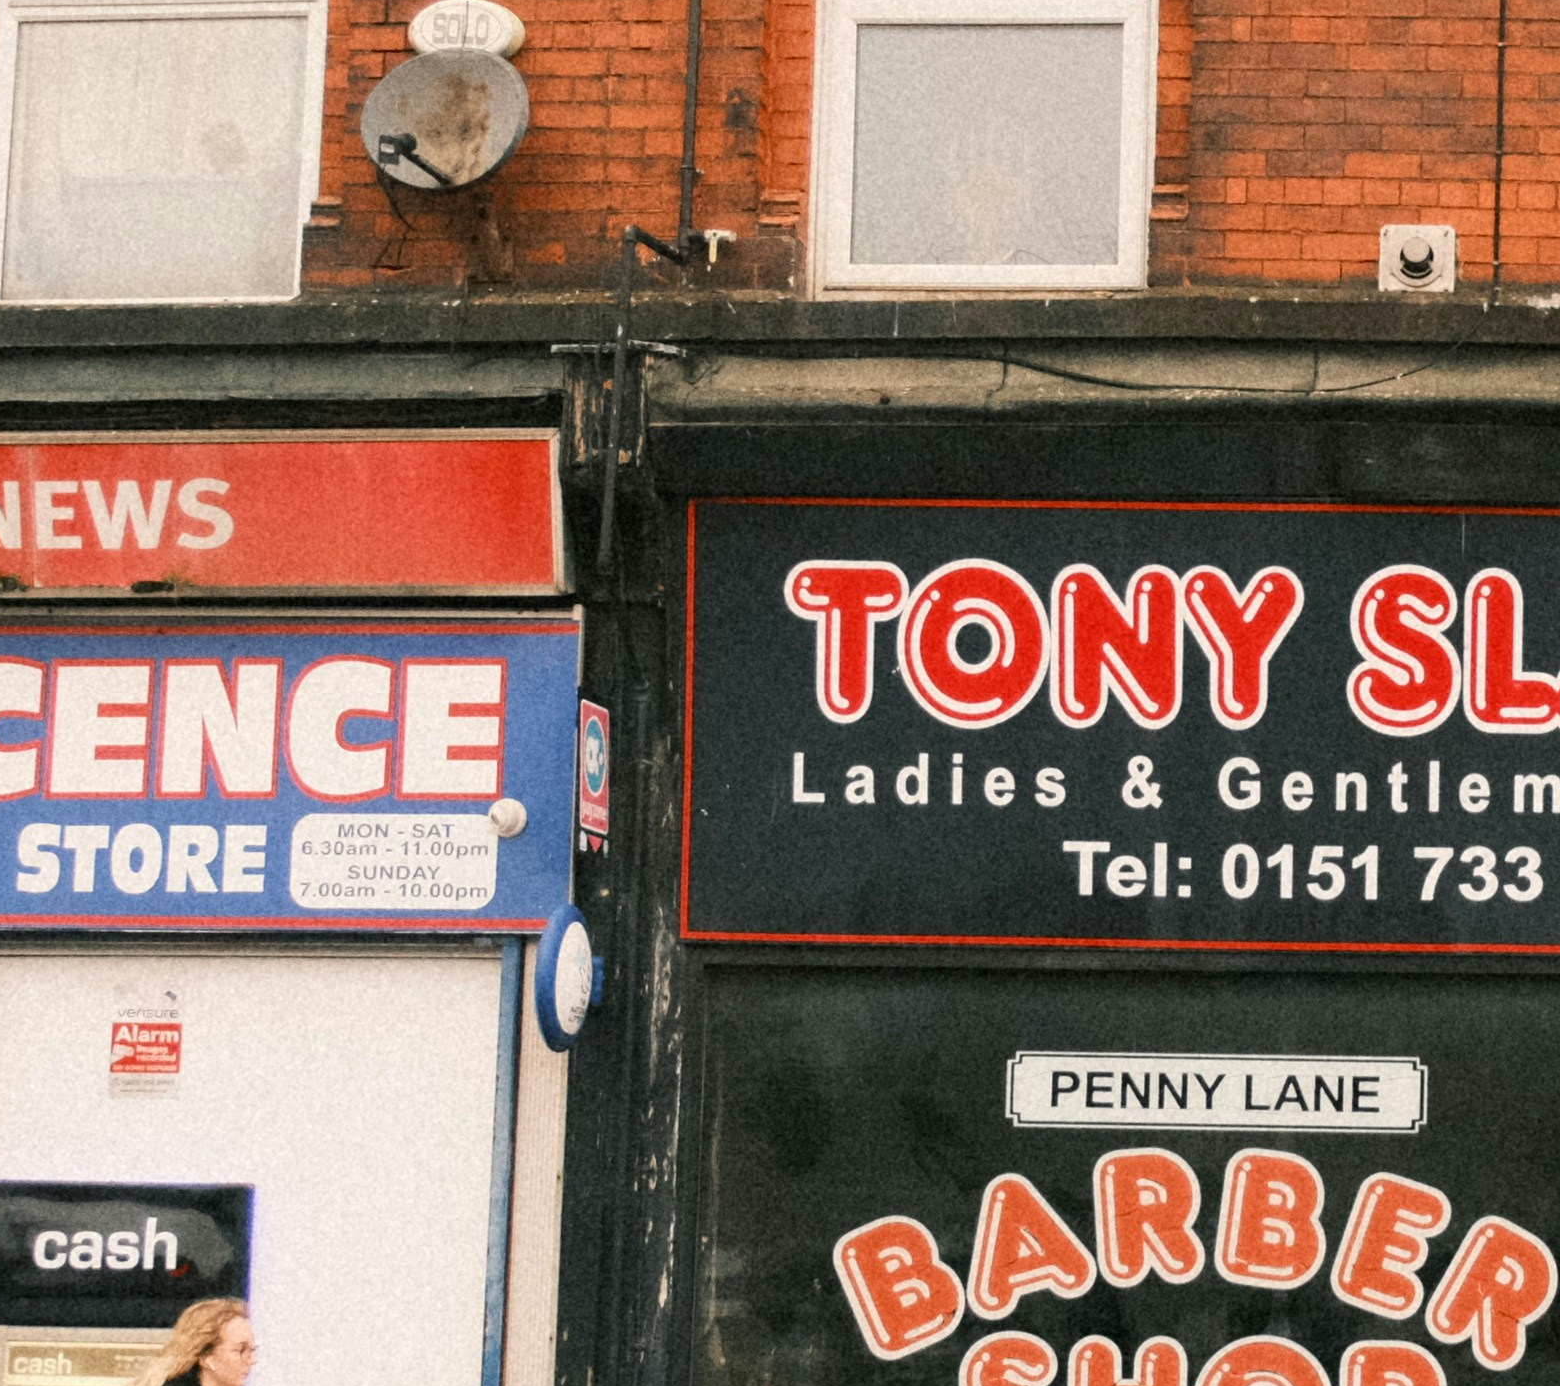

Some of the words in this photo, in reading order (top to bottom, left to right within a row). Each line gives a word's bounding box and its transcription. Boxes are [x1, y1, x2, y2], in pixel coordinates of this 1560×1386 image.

[433, 13, 489, 45] SOLO
[783, 558, 1304, 730] TONY
[793, 751, 1067, 809] Ladies
[1122, 755, 1164, 809] &
[337, 823, 389, 838] MON
[412, 823, 455, 838] SAT
[16, 822, 268, 894] STORE
[301, 841, 377, 856] 6.30am
[401, 841, 489, 859] 11.00pm
[347, 865, 441, 880] SUNDAY
[1063, 841, 1194, 898] Tel:
[1222, 844, 1378, 902] 0151
[1413, 846, 1543, 903] 733
[300, 882, 375, 897] 7.00am
[398, 883, 488, 901] 10.00pm
[117, 1008, 179, 1018] verisure
[114, 1024, 179, 1043] Alarm
[1051, 1070, 1224, 1110] PENNY
[1244, 1072, 1381, 1113] LANE
[33, 1217, 178, 1270] cash
[833, 1148, 1558, 1371] BARBER
[13, 1352, 73, 1375] cash
